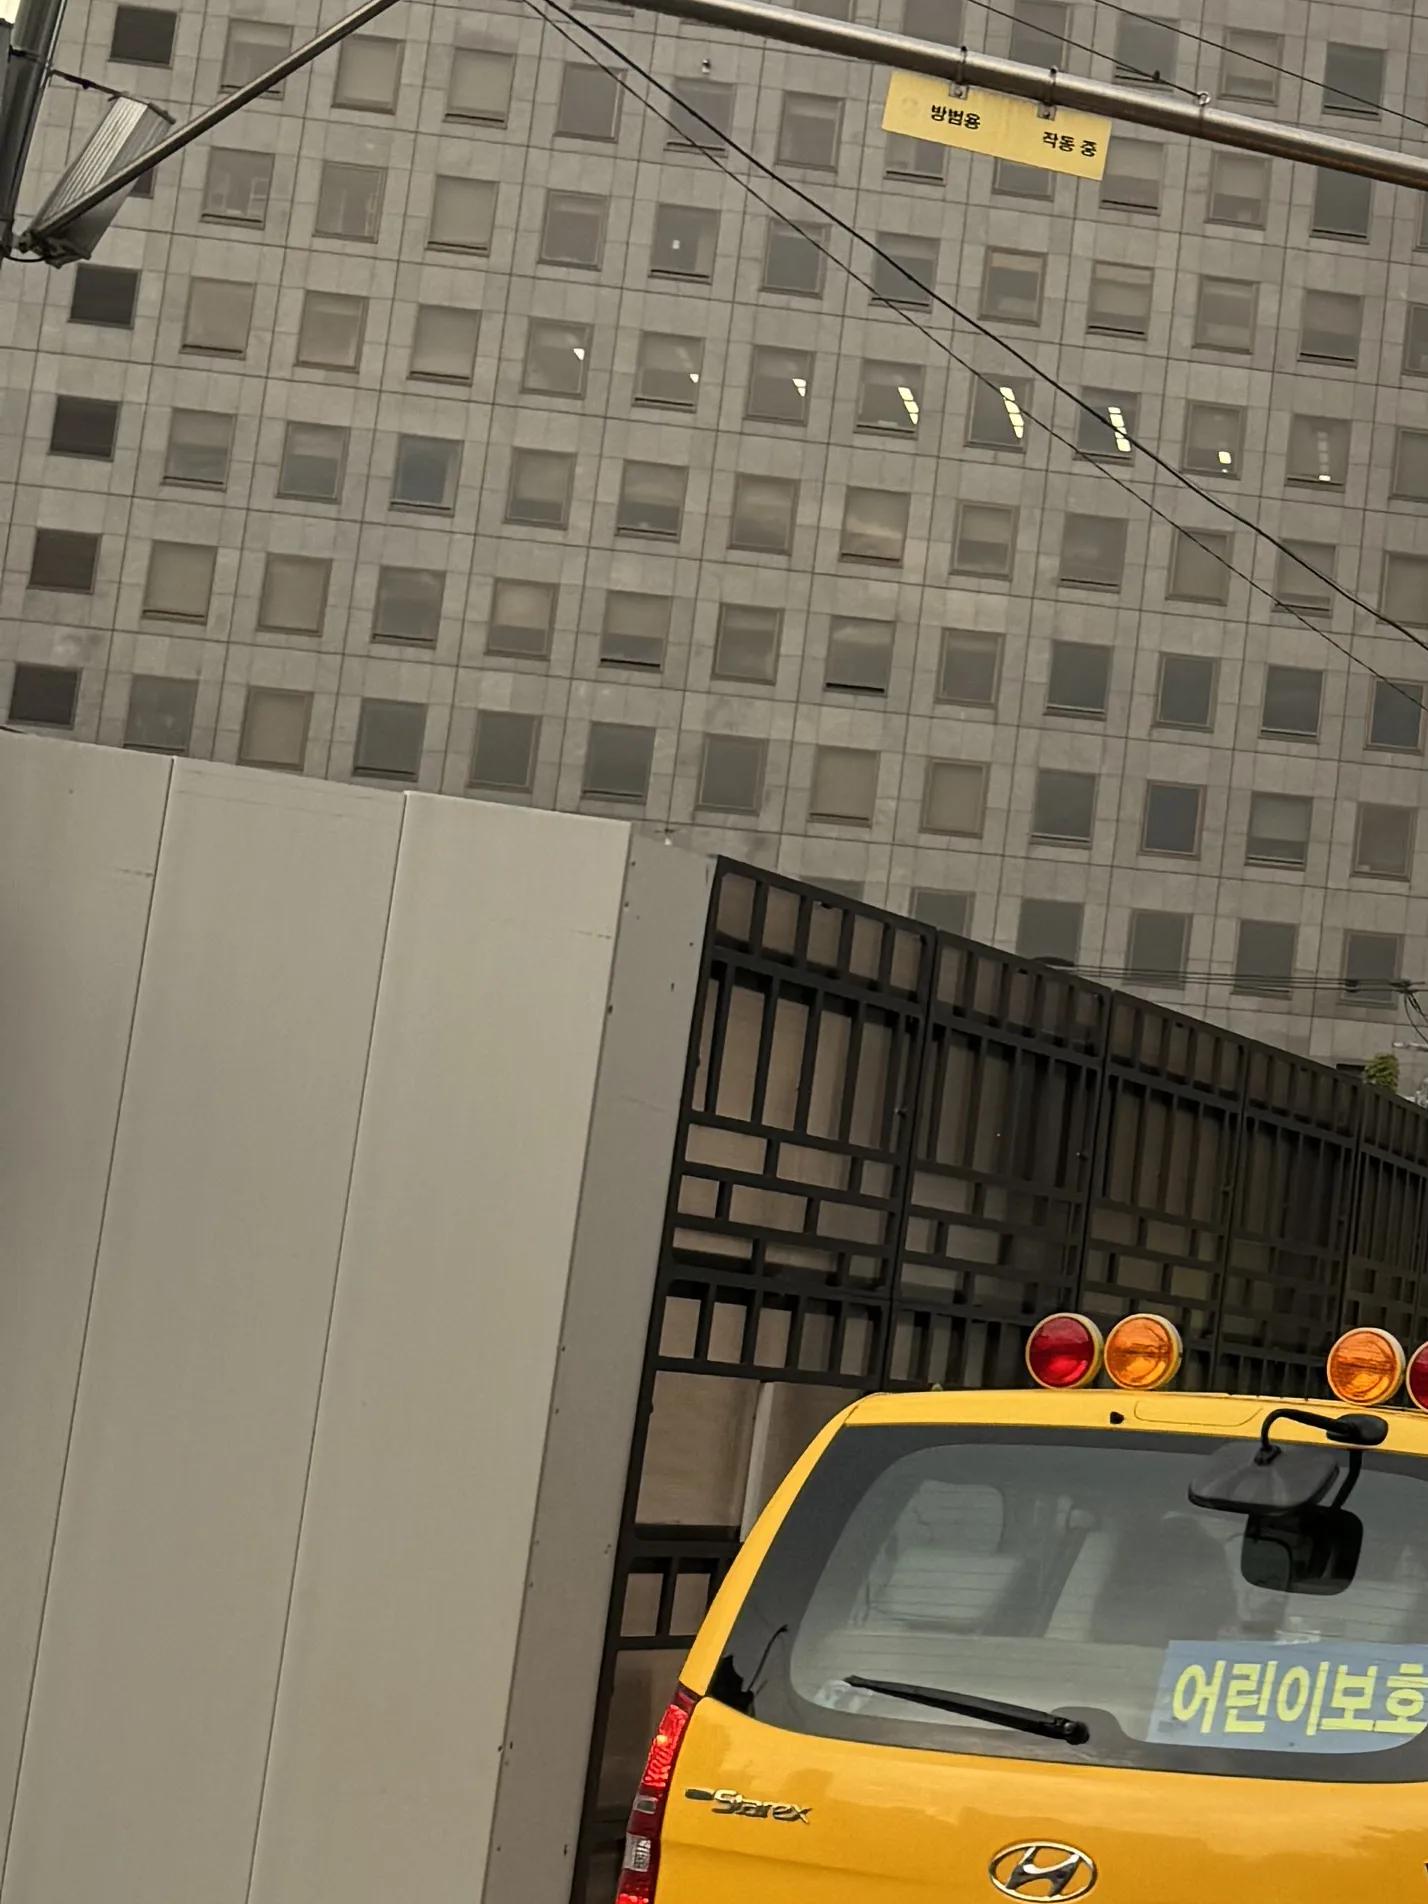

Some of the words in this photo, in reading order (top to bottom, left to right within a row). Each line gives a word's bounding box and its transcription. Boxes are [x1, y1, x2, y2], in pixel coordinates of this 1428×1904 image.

[930, 104, 981, 130] 방범용
[1043, 132, 1075, 153] 작동
[1080, 140, 1097, 158] 중
[711, 1789, 812, 1824] Starex
